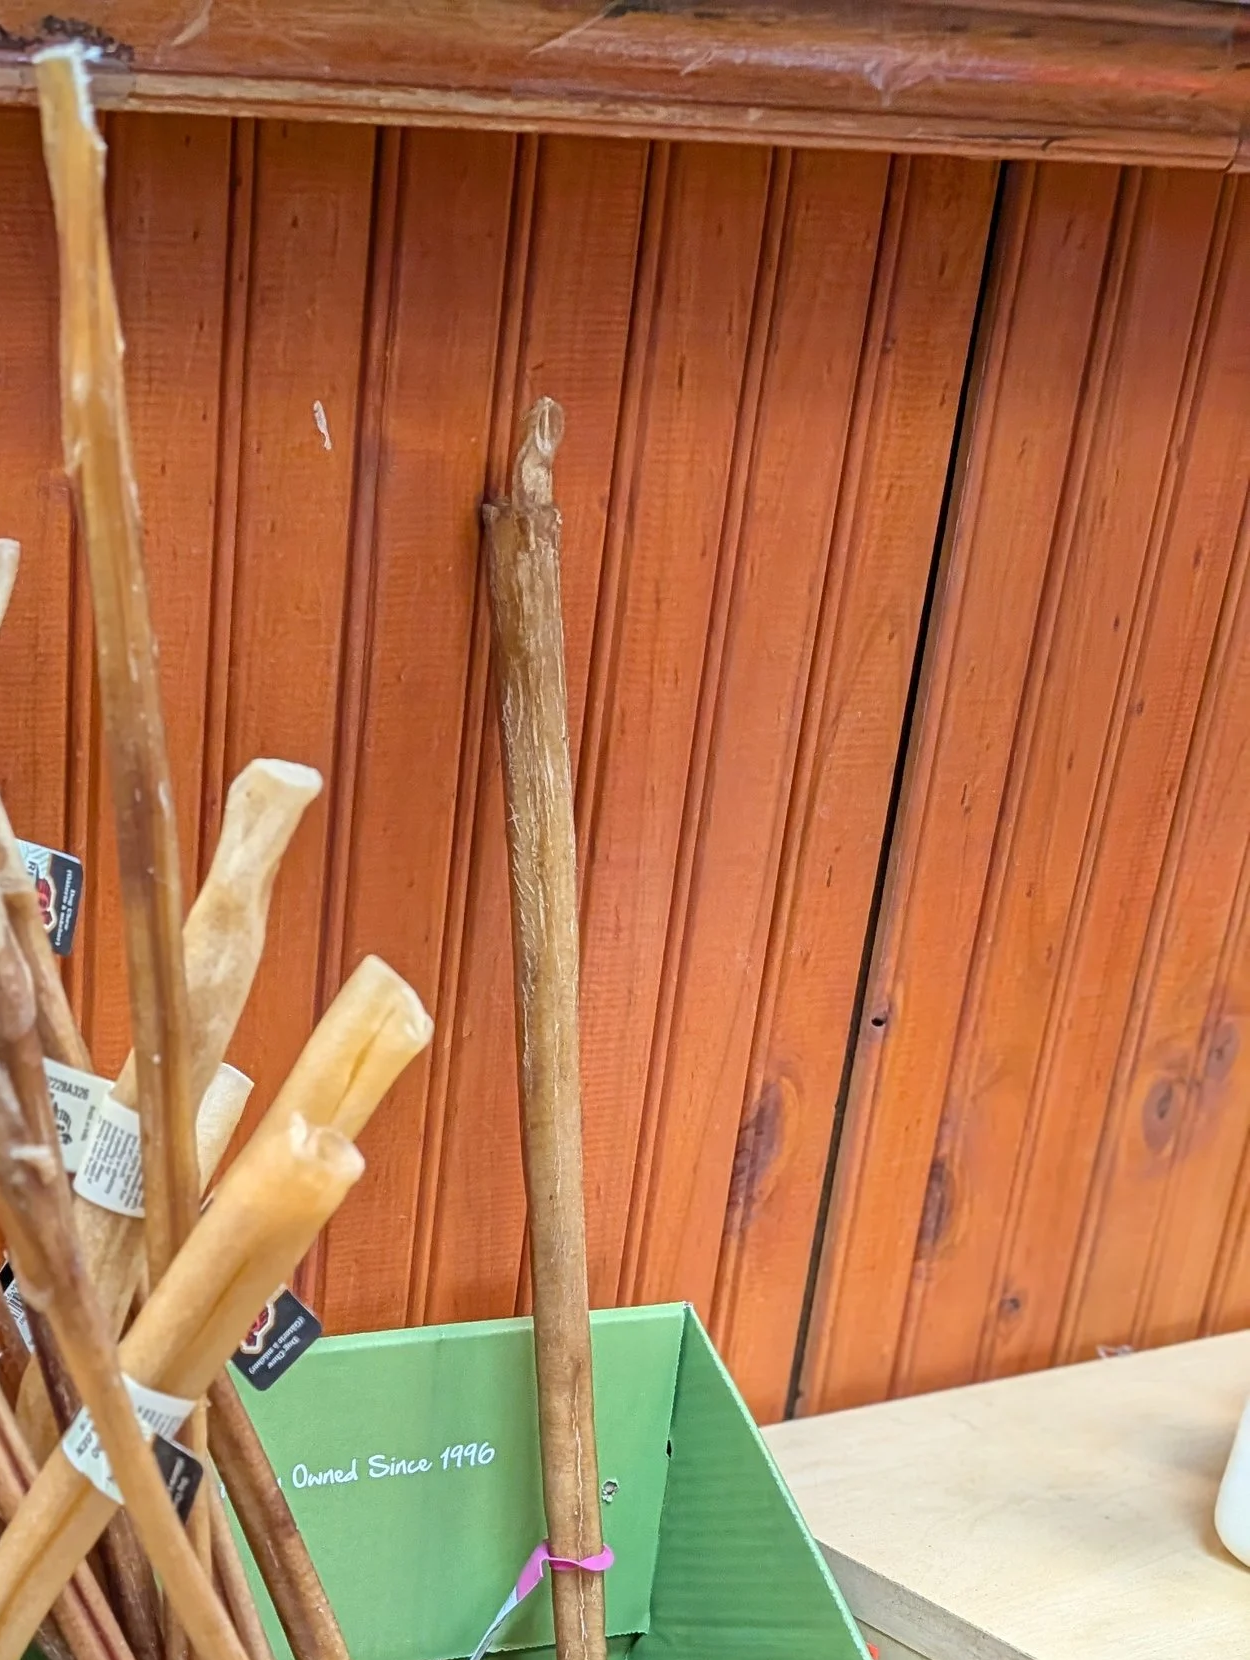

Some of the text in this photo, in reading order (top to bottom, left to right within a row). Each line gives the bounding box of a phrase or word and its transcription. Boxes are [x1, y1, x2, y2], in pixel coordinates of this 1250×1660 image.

[292, 1456, 358, 1488] Owned
[367, 1454, 432, 1478] Since
[440, 1442, 495, 1471] 1996
